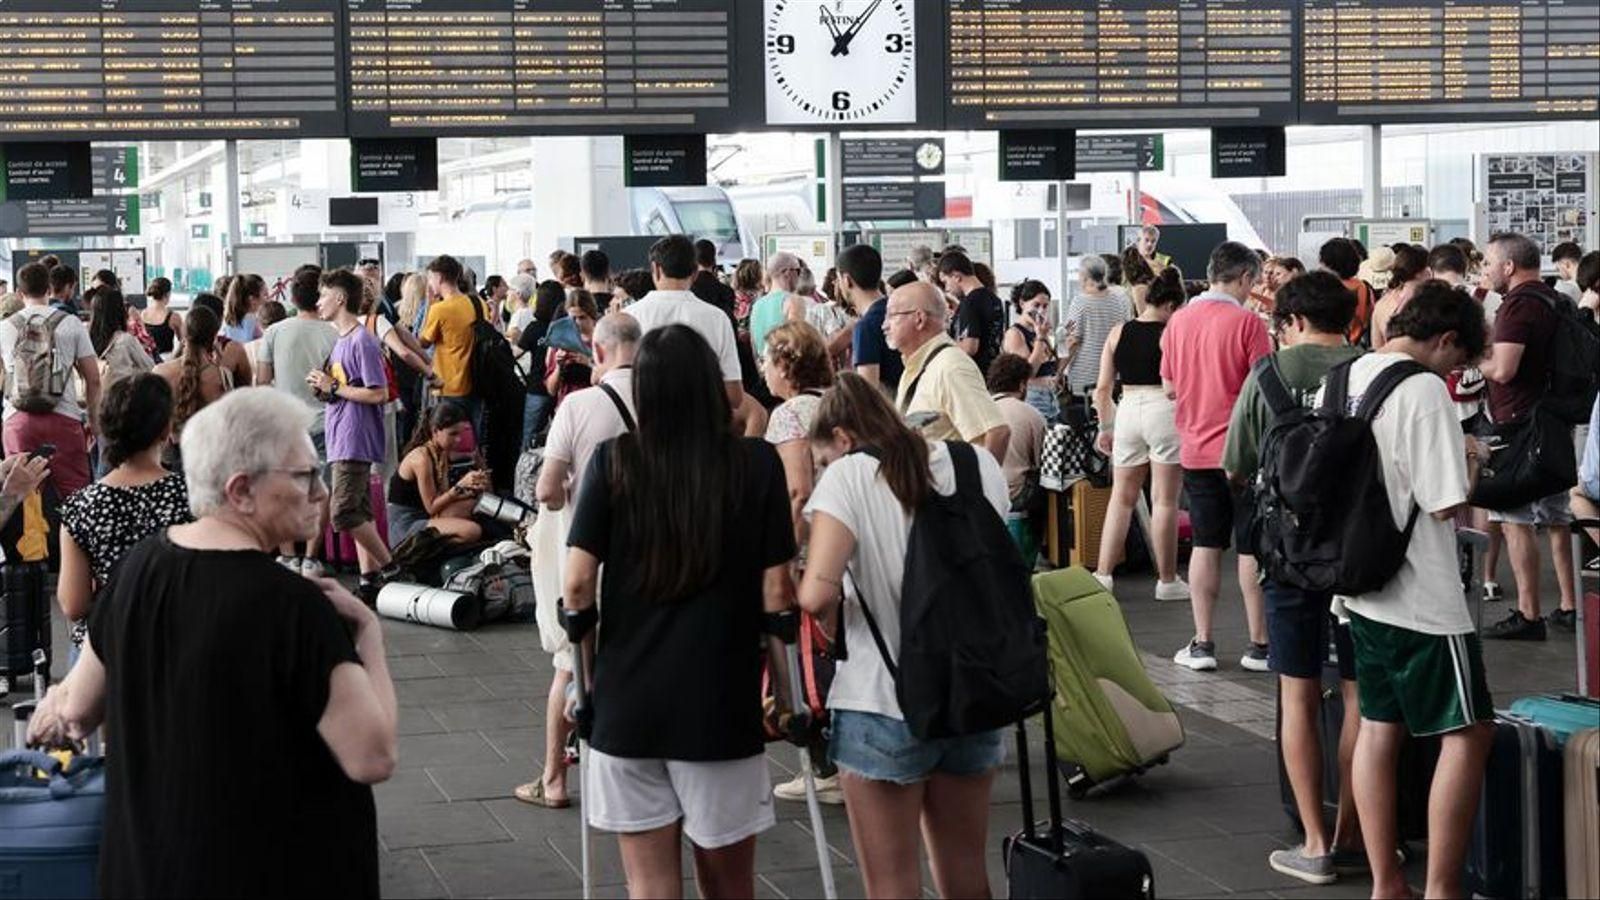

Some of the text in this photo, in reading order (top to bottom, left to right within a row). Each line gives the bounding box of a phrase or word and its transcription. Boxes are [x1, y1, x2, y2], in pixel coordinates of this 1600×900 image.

[776, 34, 795, 55] 9
[885, 33, 904, 53] 3
[831, 91, 851, 111] 6
[1146, 151, 1155, 168] 2
[113, 168, 126, 184] 4
[291, 194, 302, 209] 4
[405, 193, 415, 208] 3
[115, 215, 128, 232] 4
